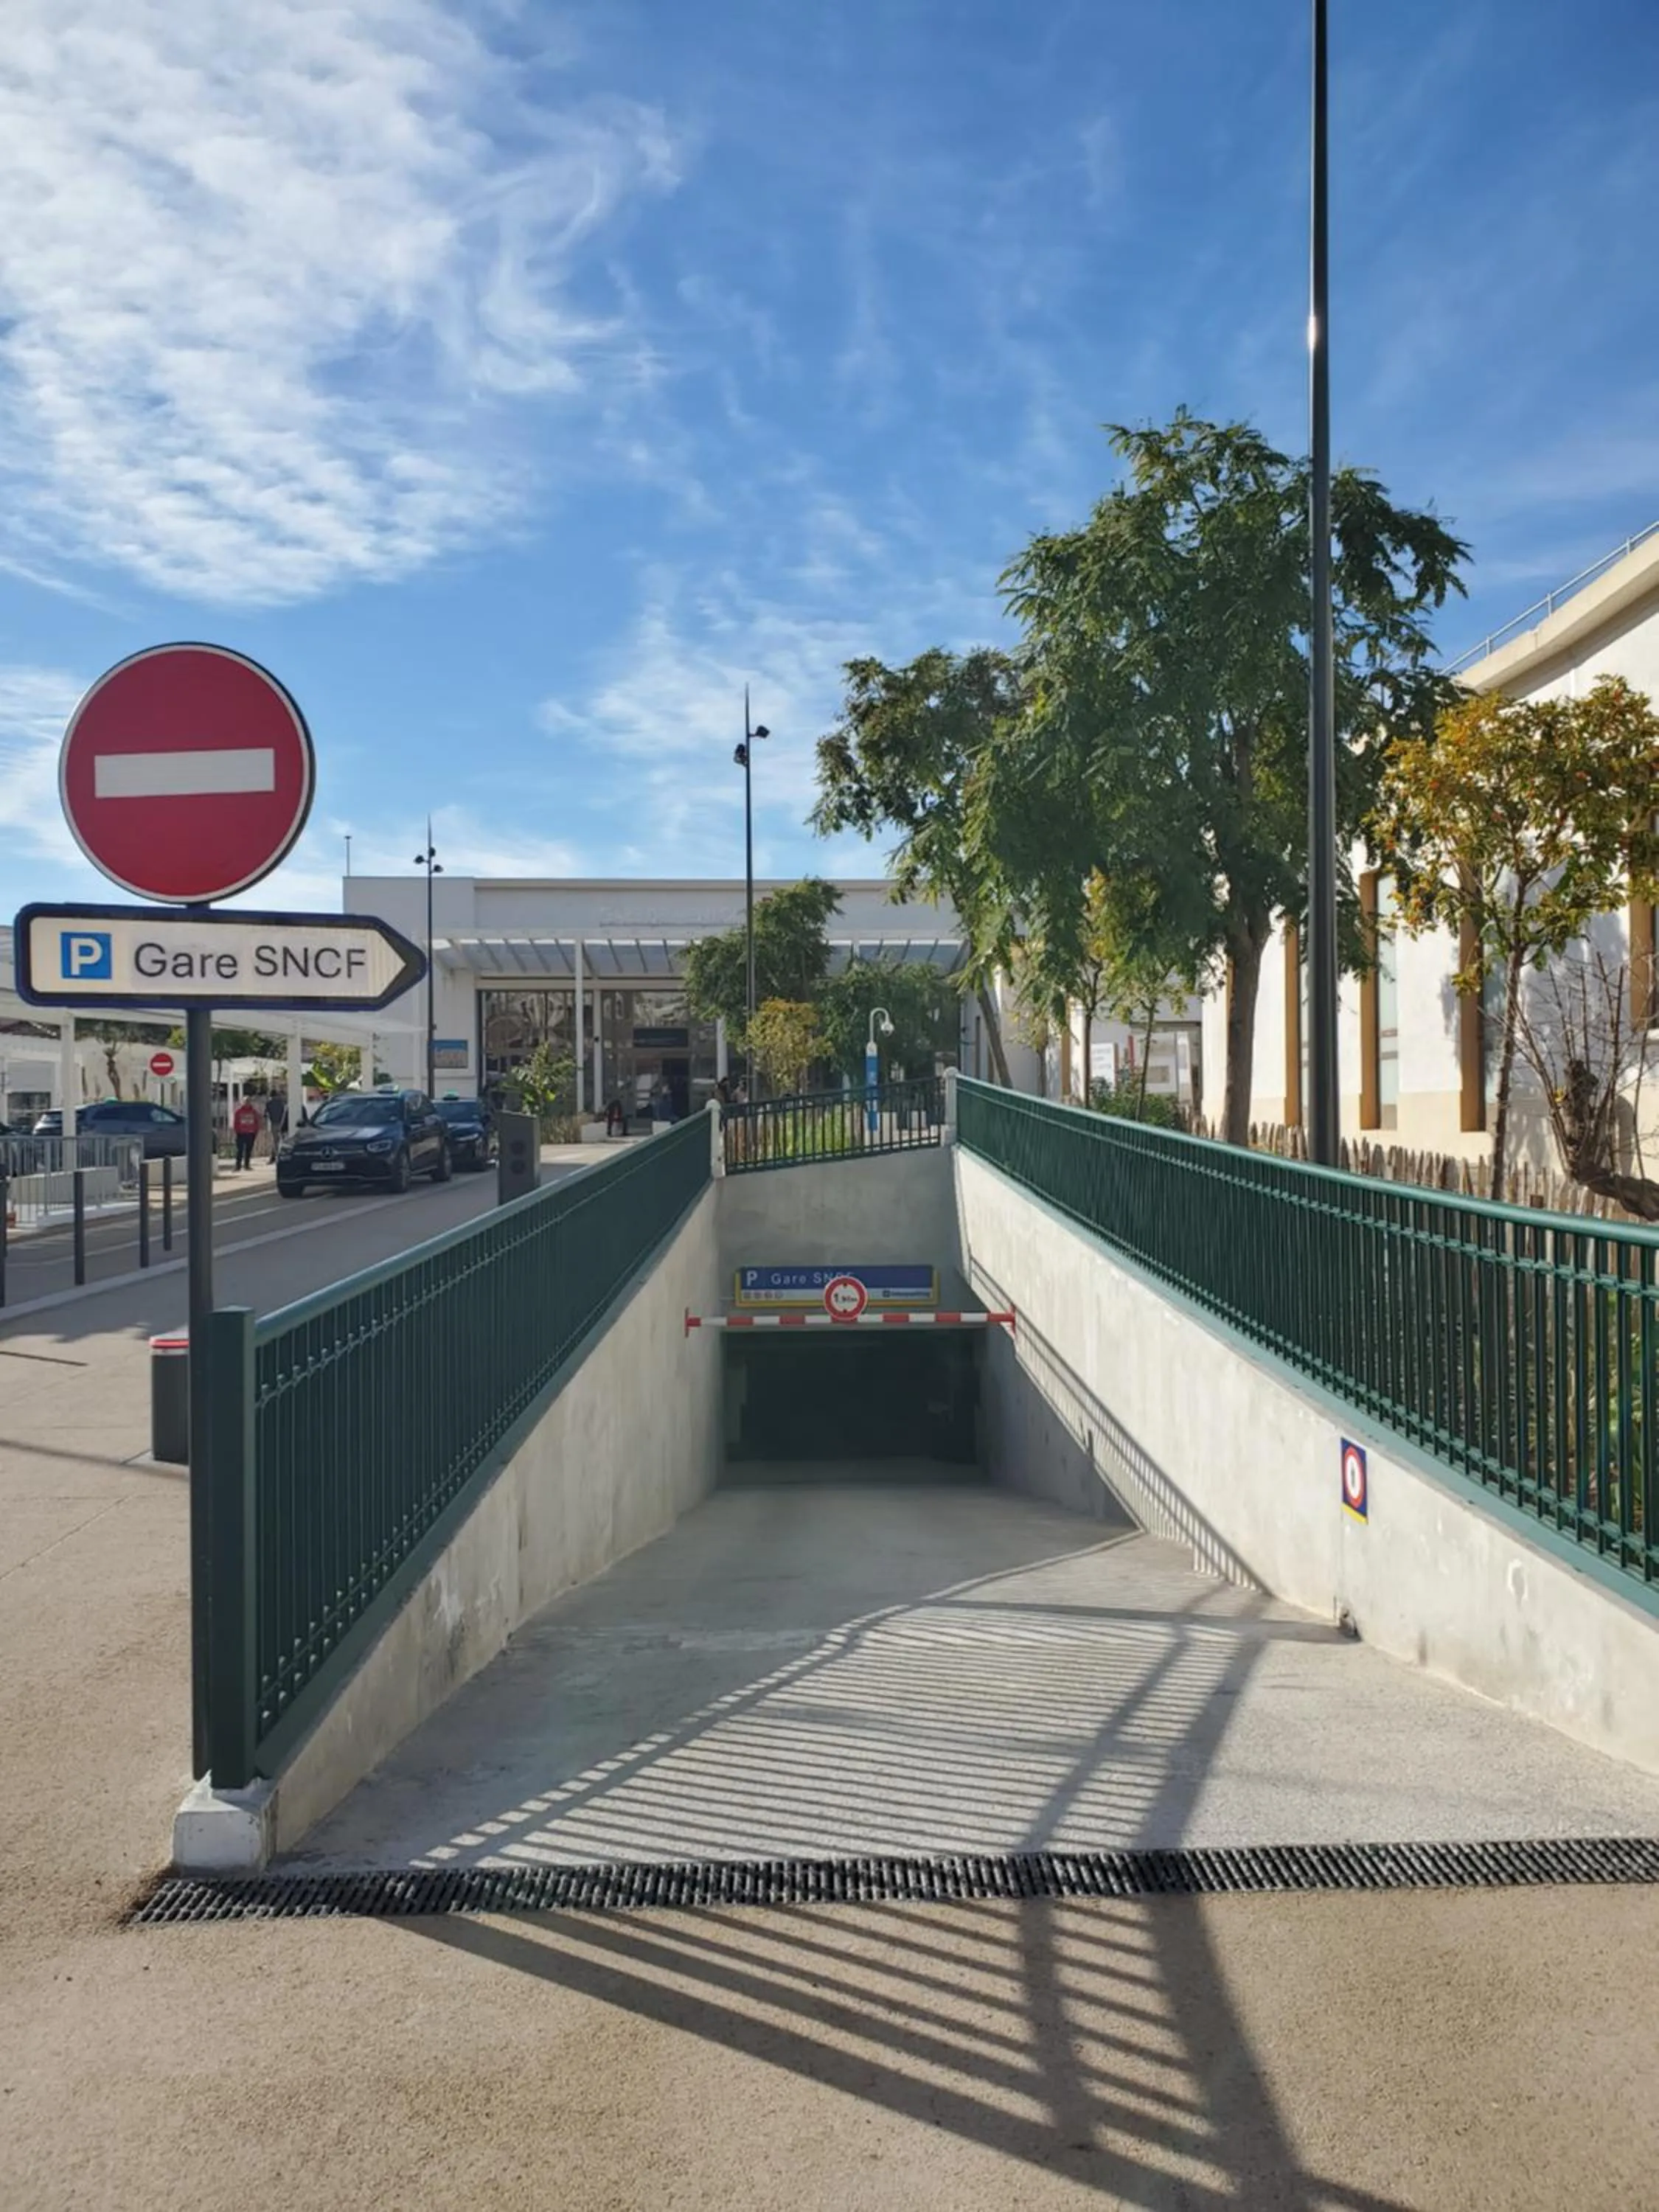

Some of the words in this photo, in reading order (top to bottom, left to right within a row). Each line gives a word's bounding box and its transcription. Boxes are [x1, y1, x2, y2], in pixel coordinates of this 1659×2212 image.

[70, 938, 102, 975] P
[134, 943, 238, 978] Gare
[254, 945, 366, 978] SNCF
[746, 1270, 757, 1287] P
[771, 1273, 807, 1284] Gare
[813, 1272, 854, 1284] SN
